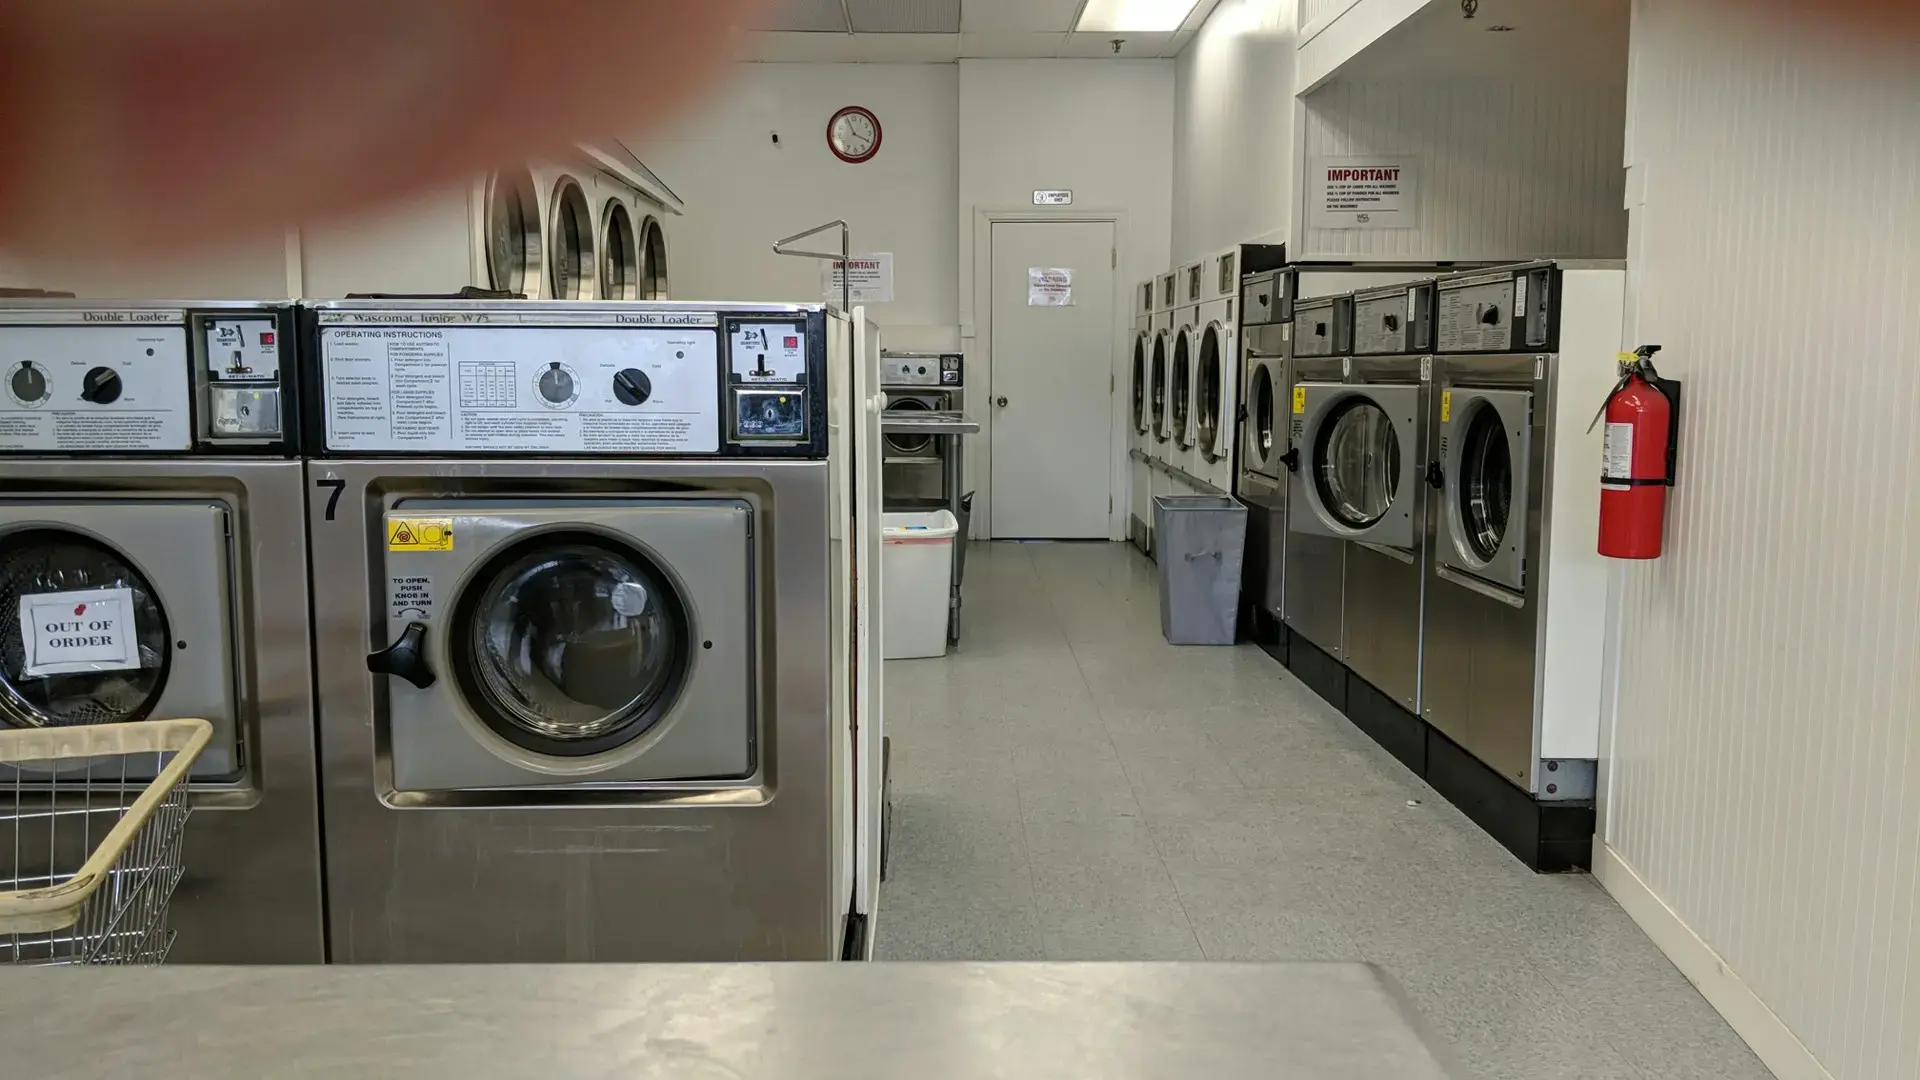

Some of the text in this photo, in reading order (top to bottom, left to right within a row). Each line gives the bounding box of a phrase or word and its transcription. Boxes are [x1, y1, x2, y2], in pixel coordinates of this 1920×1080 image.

[1327, 169, 1400, 181] IMPORTANT
[83, 312, 169, 321] Double Loader
[353, 314, 413, 323] Wascomat
[616, 314, 701, 324] Double Loader
[317, 480, 346, 520] 7
[46, 620, 113, 633] OUT OF
[50, 636, 113, 648] ORDER
